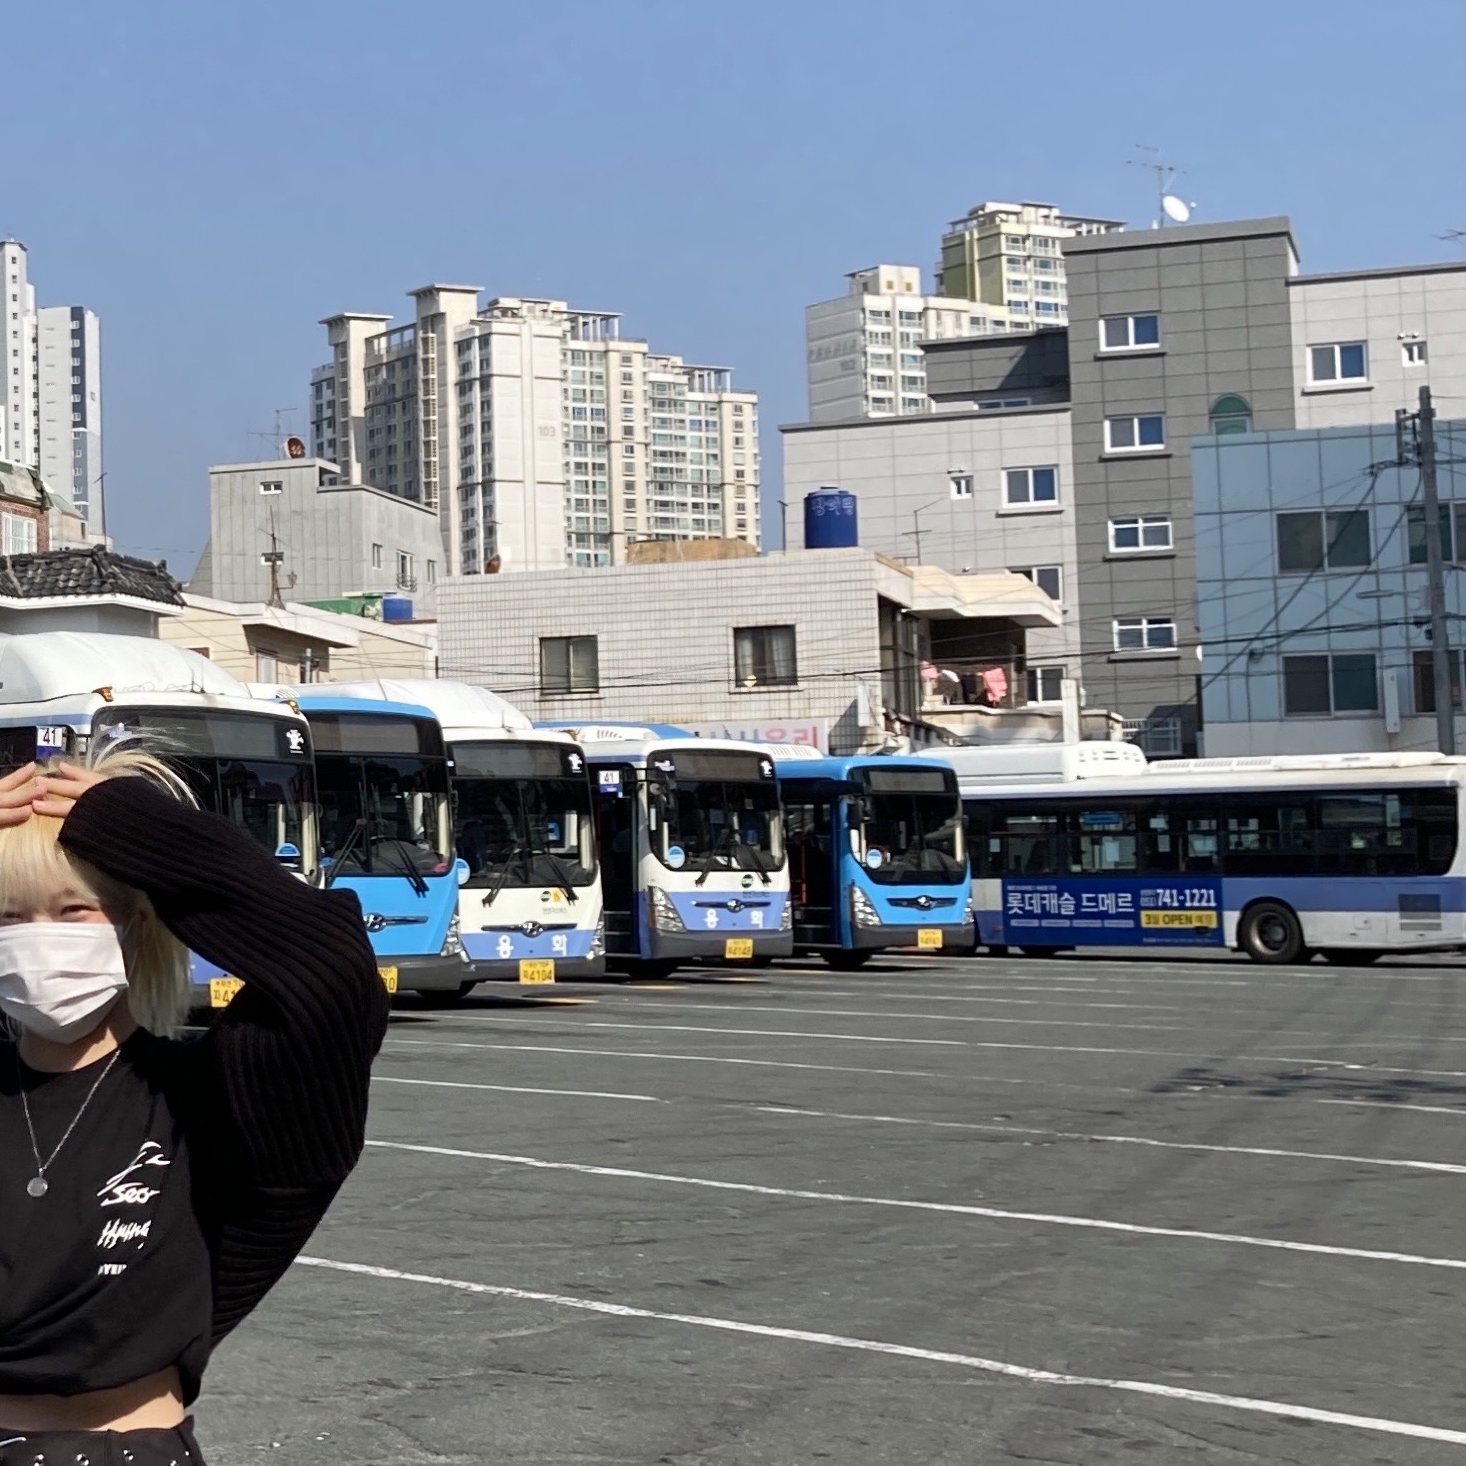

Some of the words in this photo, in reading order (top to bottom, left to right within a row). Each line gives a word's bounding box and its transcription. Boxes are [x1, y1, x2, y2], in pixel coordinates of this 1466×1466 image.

[43, 728, 56, 745] 41
[604, 773, 615, 784] 41
[1007, 892, 1076, 915] 롯데캐슬
[1080, 892, 1134, 914] 드메르
[1156, 889, 1217, 907] 741-1221
[1162, 914, 1193, 925] OPEN
